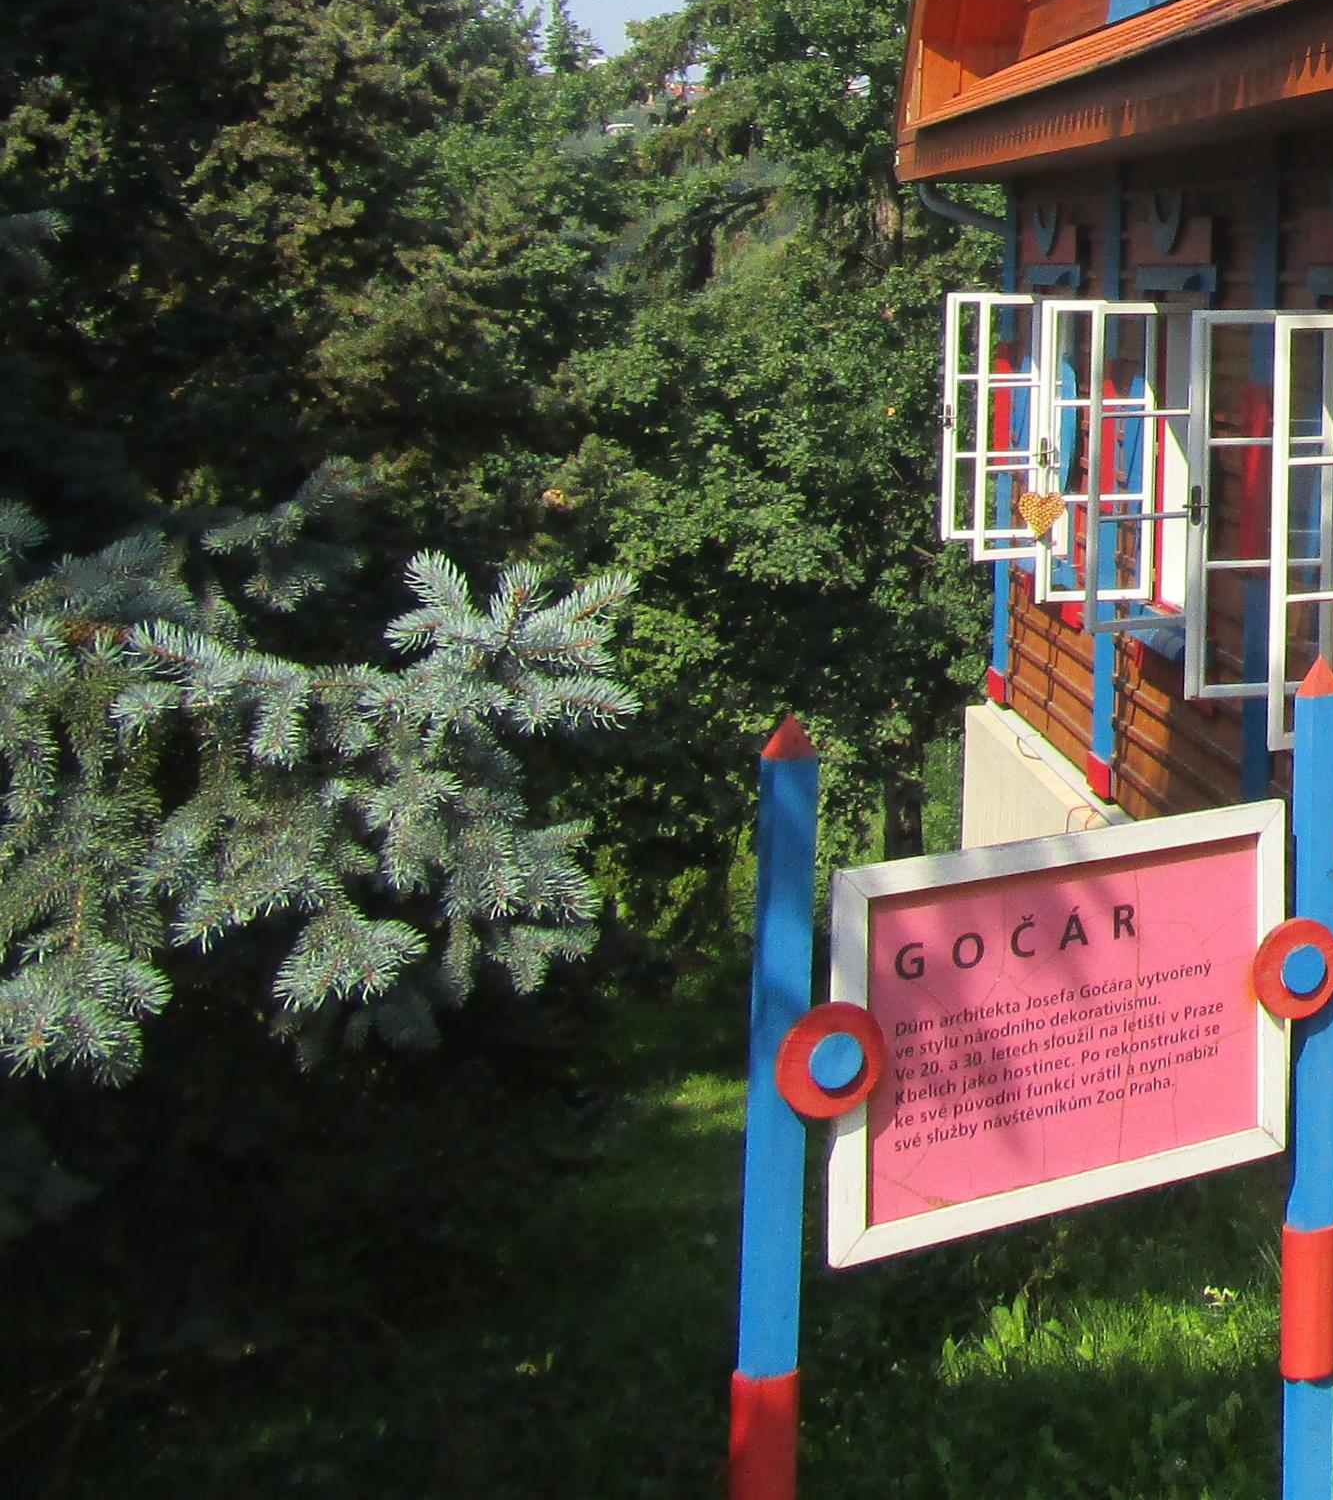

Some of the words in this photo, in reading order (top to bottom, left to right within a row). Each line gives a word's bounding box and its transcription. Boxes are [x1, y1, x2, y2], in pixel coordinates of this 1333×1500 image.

[894, 903, 1136, 981] GOČÁR
[895, 1019, 934, 1038] Dům
[939, 1001, 1020, 1029] architekta
[1025, 987, 1075, 1011] Josefa
[1080, 978, 1133, 999] Gočára
[1138, 959, 1212, 989] vytvořený
[895, 1045, 914, 1060] ve
[919, 1032, 959, 1055] stylu
[964, 1014, 1046, 1046] národního
[1050, 995, 1162, 1027] dekorativismu.
[894, 1067, 915, 1082] Ve
[920, 1061, 944, 1078] 20.
[948, 1059, 958, 1071] a
[963, 1051, 987, 1069] 30.
[991, 1039, 1039, 1061] letech
[1043, 1027, 1094, 1050] sloužil
[1099, 1024, 1118, 1039] na
[1123, 1010, 1166, 1033] letišti
[1170, 1011, 1179, 1023] v
[1184, 1001, 1224, 1021] Praze
[894, 1078, 957, 1106] Kbelích
[961, 1073, 998, 1095] jako
[1003, 1056, 1076, 1082] hostinec.
[1081, 1049, 1100, 1064] Po
[1105, 1024, 1200, 1060] rekonstrukci
[1204, 1023, 1221, 1037] se
[894, 1132, 922, 1152] své
[926, 1121, 979, 1145] služby
[983, 1094, 1093, 1131] návštěvníkům
[1096, 1086, 1125, 1105] Zoo
[1129, 1075, 1176, 1097] Praha.
[895, 1112, 915, 1129] ke
[920, 1104, 948, 1123] své
[953, 1085, 1022, 1119] původní
[1026, 1074, 1076, 1098] funkci
[1081, 1063, 1121, 1086] vrátil
[1126, 1065, 1135, 1076] a
[1139, 1052, 1172, 1075] nyní
[1175, 1041, 1220, 1064] nabízí
